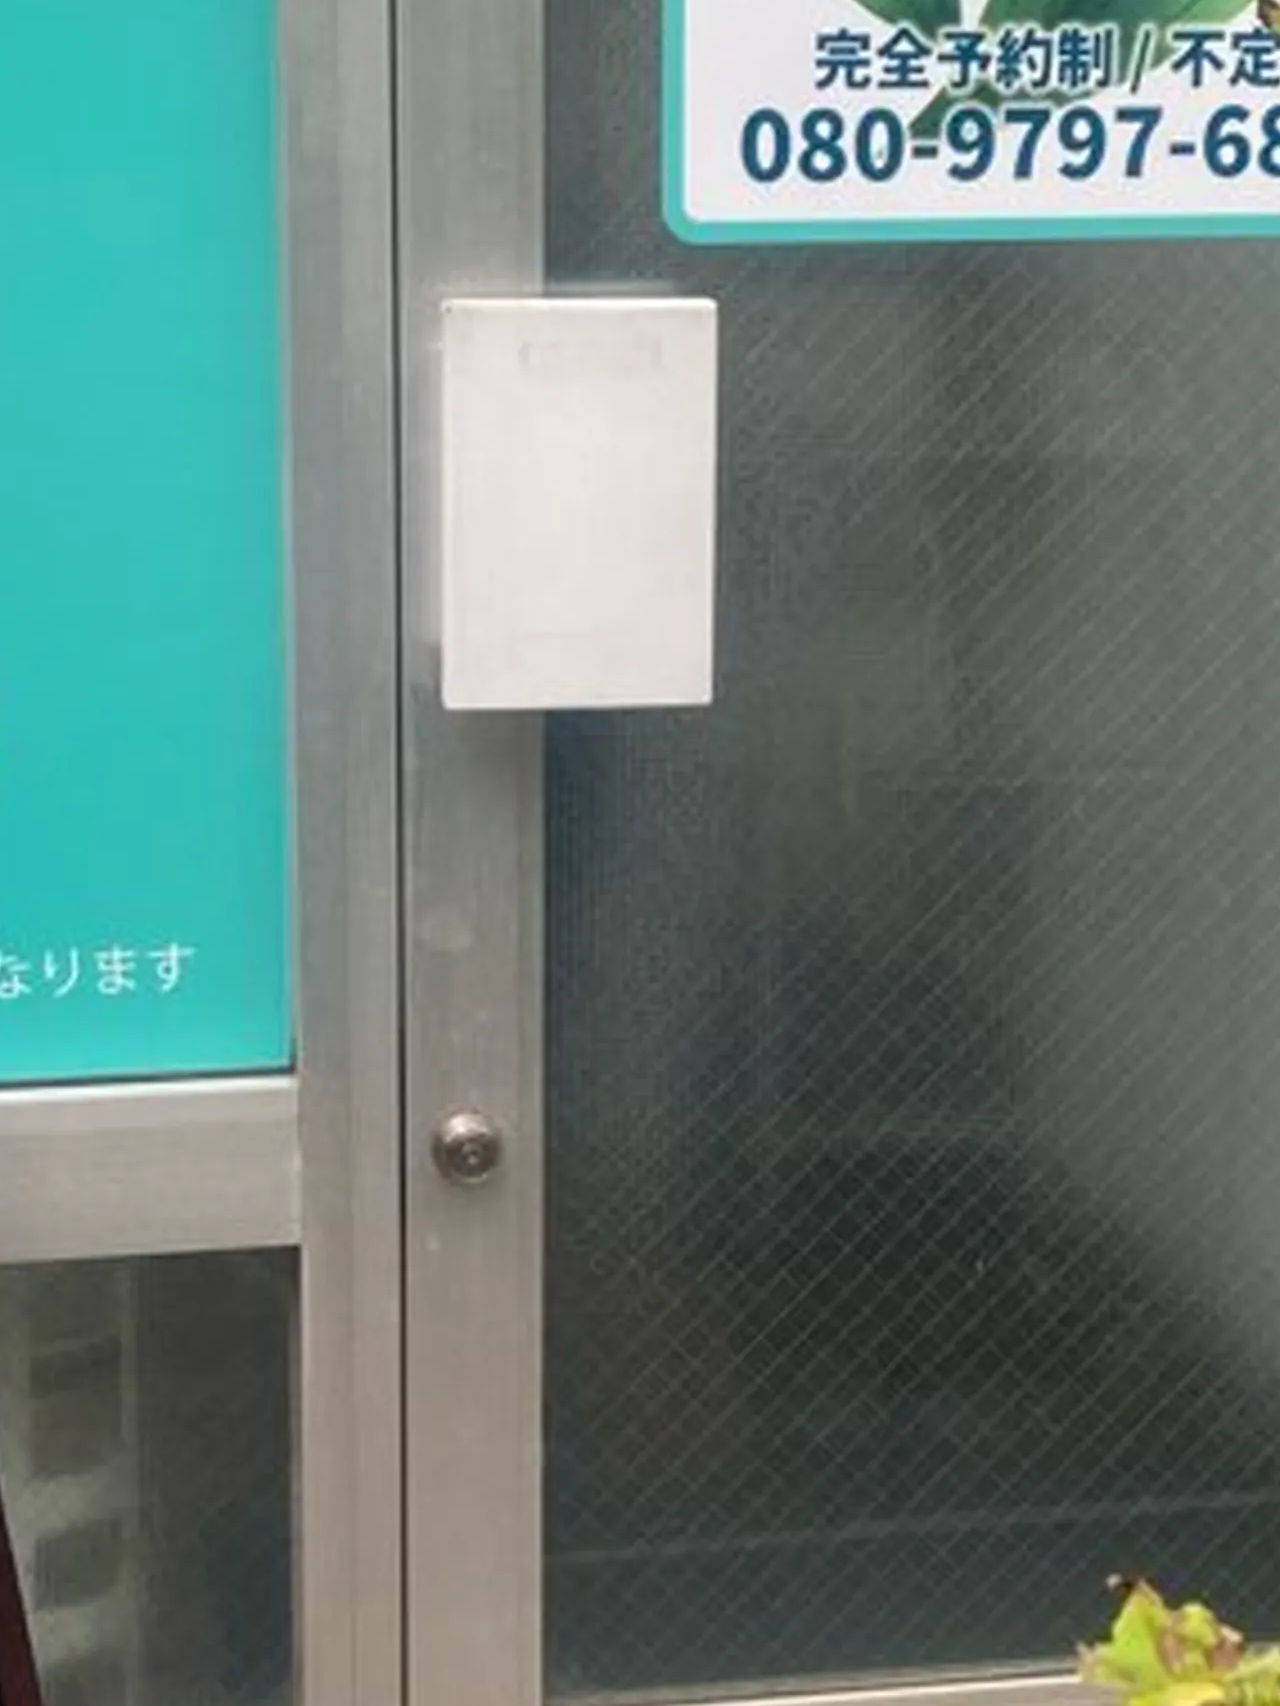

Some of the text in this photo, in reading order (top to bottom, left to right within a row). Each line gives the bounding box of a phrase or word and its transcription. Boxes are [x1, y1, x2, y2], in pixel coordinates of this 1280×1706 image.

[813, 28, 1113, 90] 完全予約制
